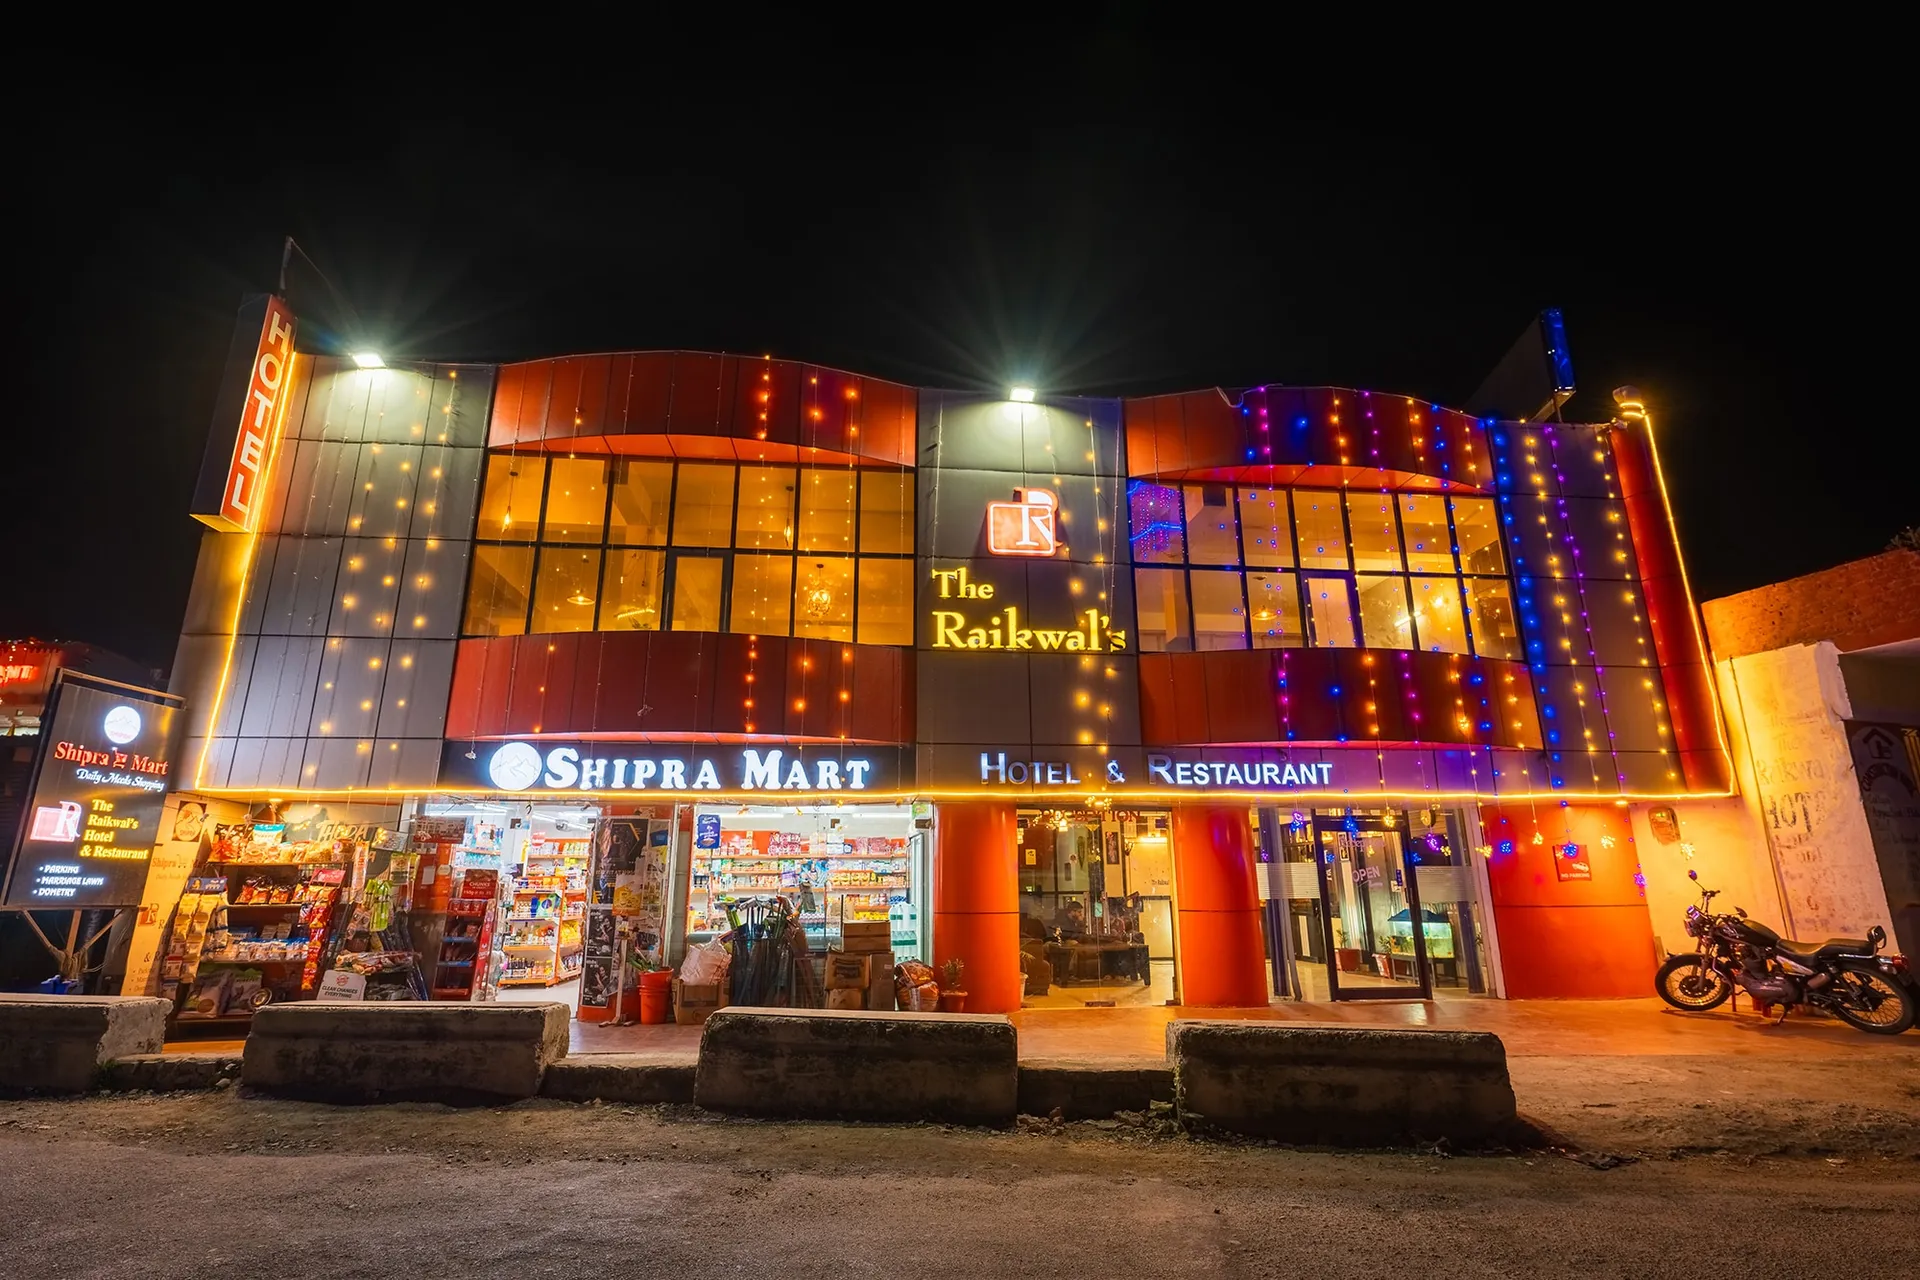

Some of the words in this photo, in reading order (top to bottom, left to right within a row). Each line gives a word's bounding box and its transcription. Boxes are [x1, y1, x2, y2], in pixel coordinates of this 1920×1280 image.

[231, 311, 291, 514] HOTEL
[932, 566, 995, 600] The
[931, 606, 1127, 652] Raikwal's
[54, 741, 110, 767] Shipra
[131, 754, 168, 775] Mart
[543, 747, 721, 791] SHIPRA
[740, 748, 871, 791] MART
[1105, 759, 1126, 783] &
[1147, 753, 1334, 786] RESTAURANT
[76, 768, 103, 784] Daily
[131, 775, 165, 792] Shopping
[91, 798, 114, 812] The
[87, 814, 139, 830] Raikwal's
[84, 830, 114, 843] Hotel
[80, 845, 92, 858] &
[94, 845, 149, 860] Restaurant
[44, 864, 80, 874] PARKING
[1352, 865, 1381, 883] OPEN
[324, 991, 352, 999] EVERYTHING
